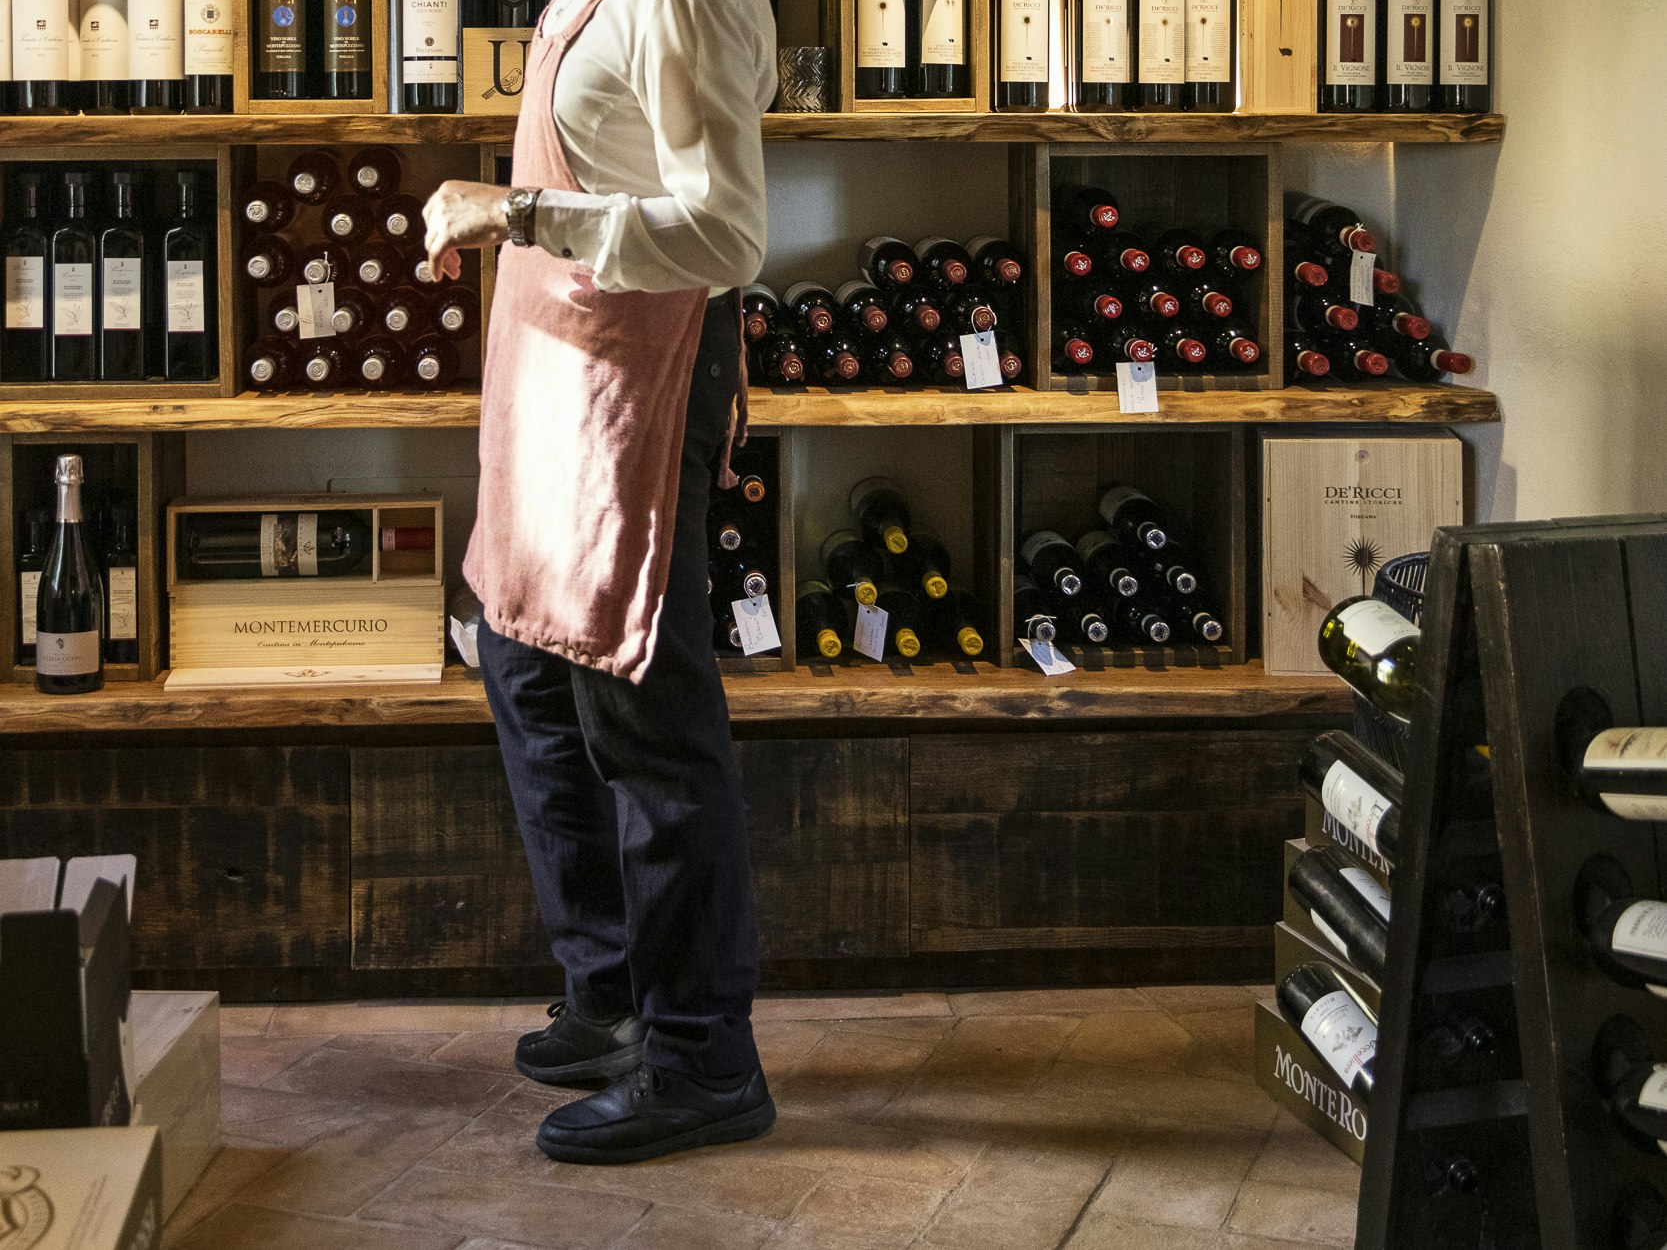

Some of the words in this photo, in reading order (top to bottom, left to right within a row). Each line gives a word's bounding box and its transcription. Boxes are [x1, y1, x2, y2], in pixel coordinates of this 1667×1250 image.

[1341, 63, 1370, 72] VIGNONE
[1404, 63, 1430, 72] VIGNONE
[1456, 63, 1484, 72] VIGNONE
[1324, 485, 1402, 500] DE'RICCI
[234, 618, 388, 634] MONTEMERCURIO
[256, 639, 290, 647] Cantina
[304, 638, 366, 649] Montepulciano
[1273, 1044, 1367, 1141] MONTERO
